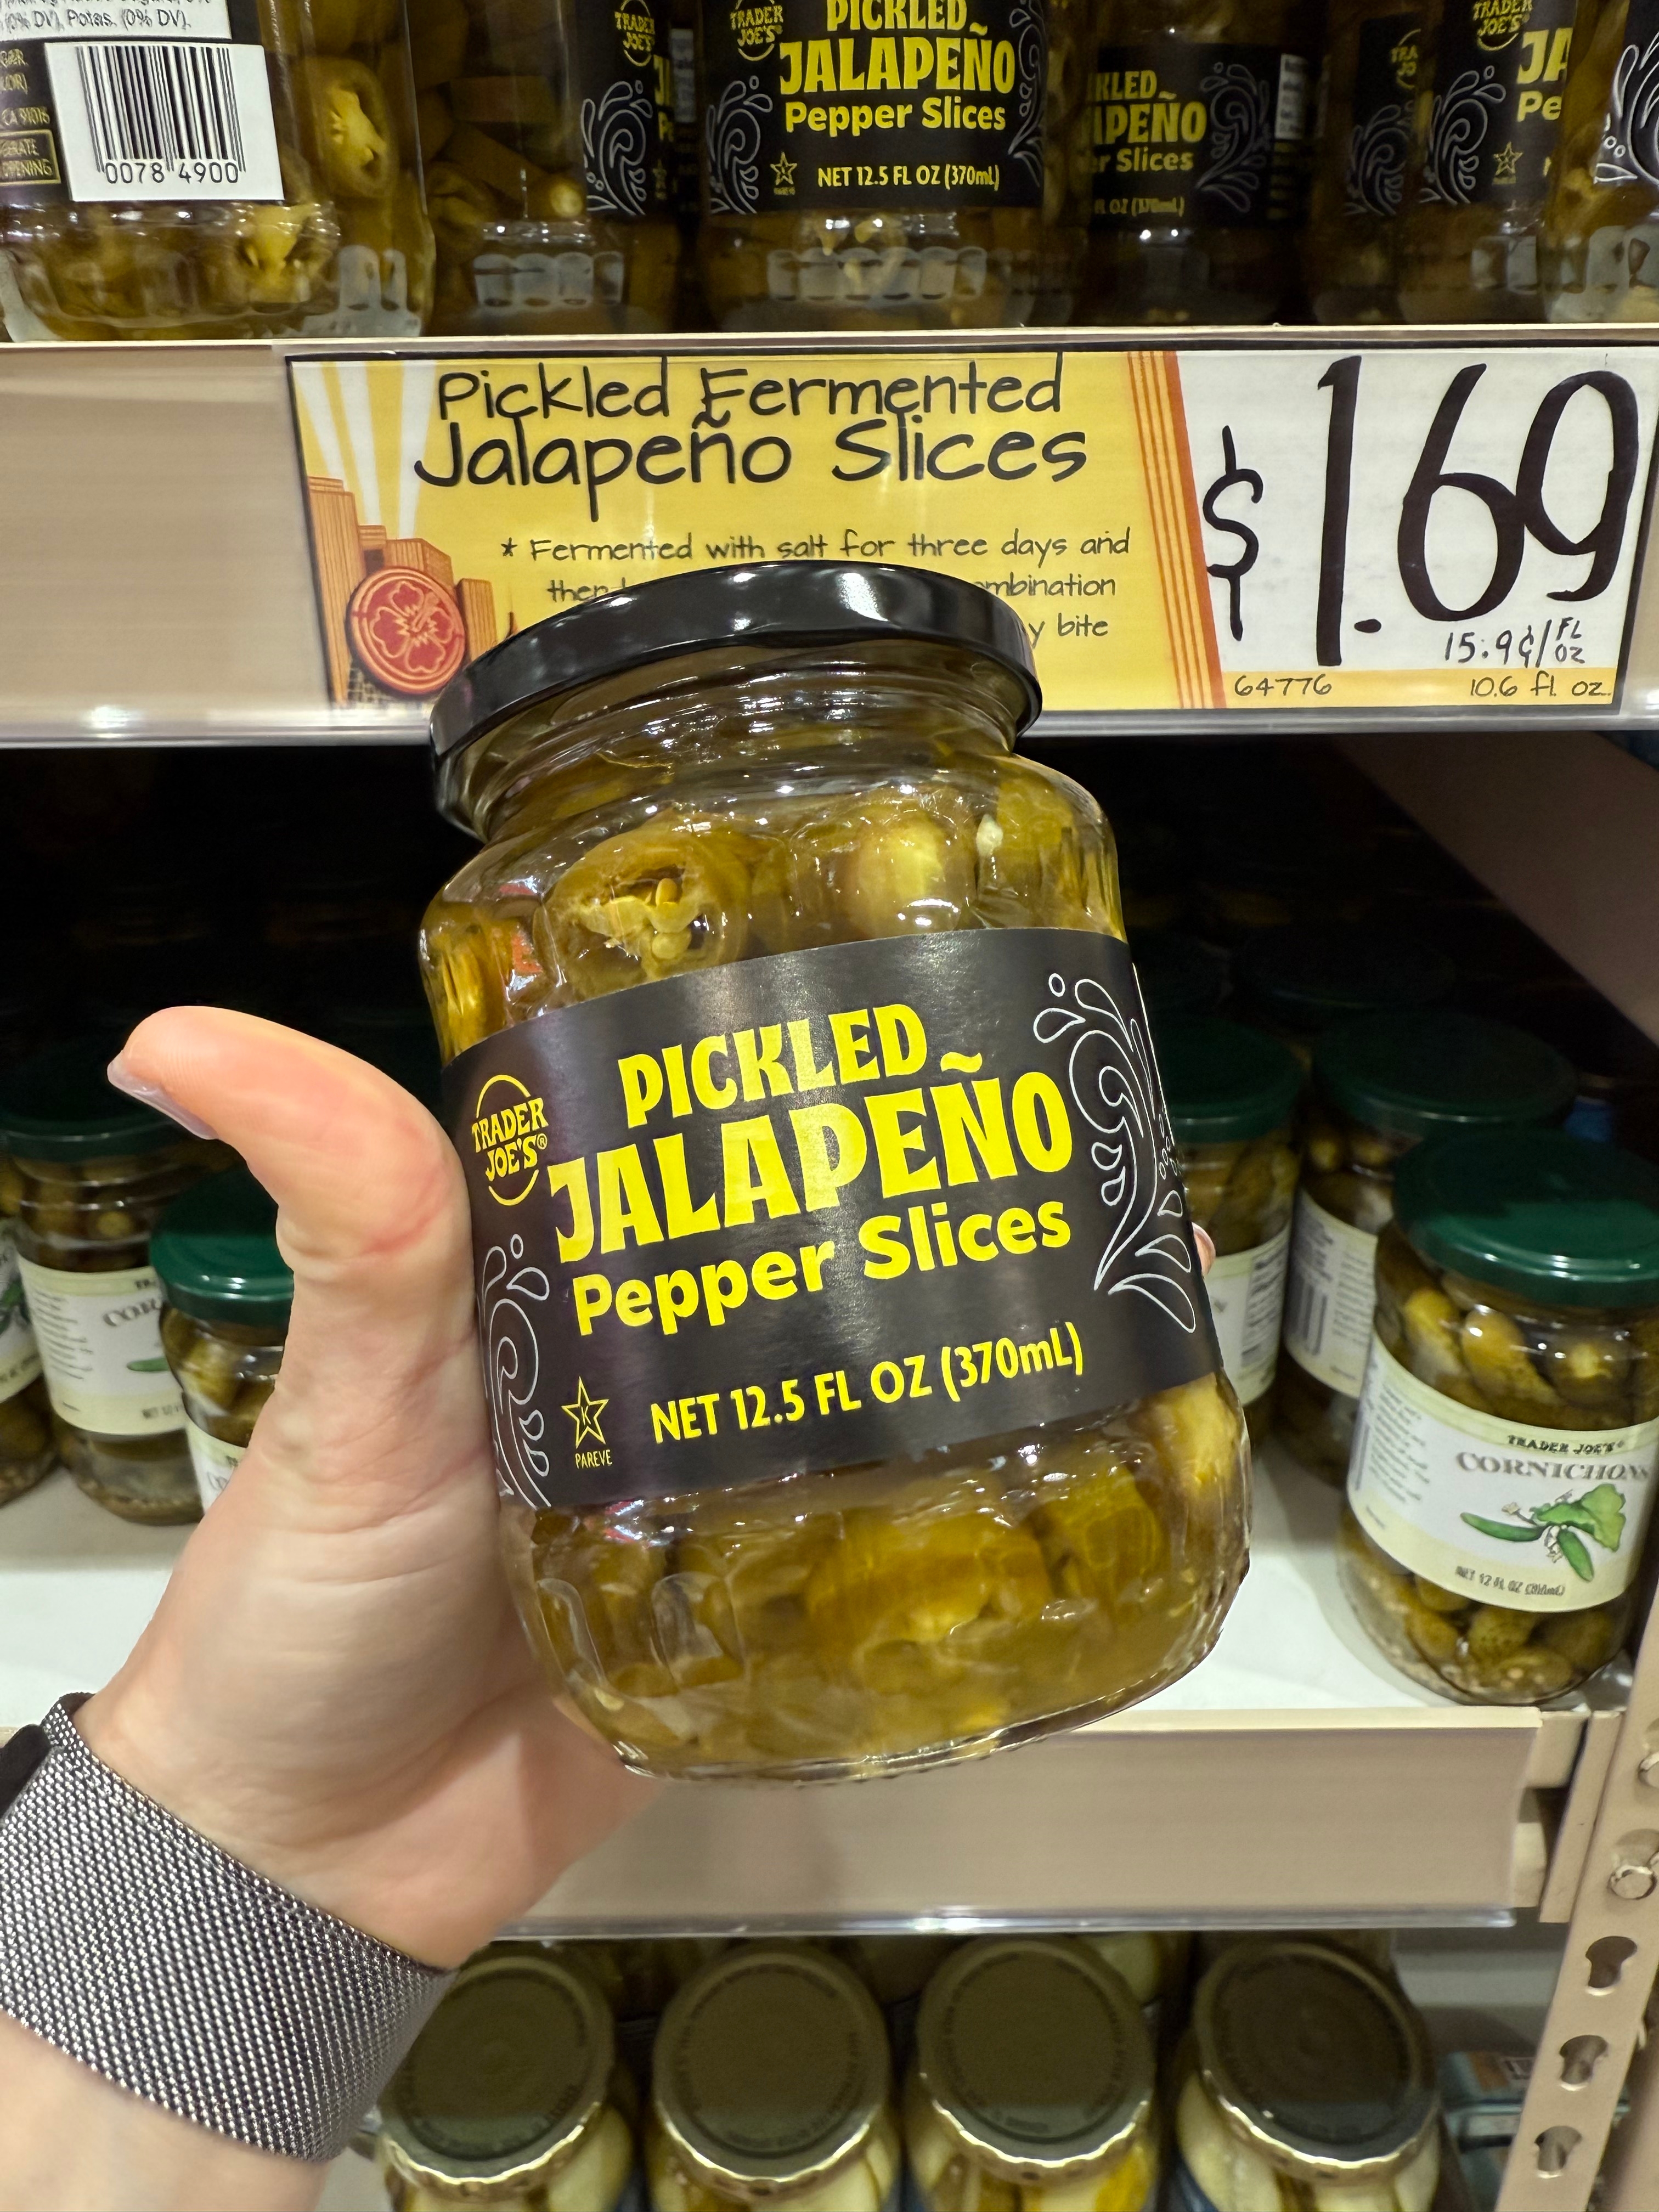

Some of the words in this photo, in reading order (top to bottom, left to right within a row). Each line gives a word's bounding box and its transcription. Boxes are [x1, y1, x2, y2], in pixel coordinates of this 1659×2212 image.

[121, 9, 153, 31] (0%
[730, 4, 784, 30] TRADER
[826, 0, 968, 32] PICKLED
[779, 22, 1015, 94] JALAPEÑO
[785, 101, 912, 138] Pepper
[922, 95, 1006, 131] Slices
[1116, 146, 1194, 172] Slices
[817, 166, 853, 188] NET
[856, 166, 889, 187] 12.5
[893, 165, 912, 187] FL
[916, 165, 941, 185] OZ
[944, 163, 1000, 191] (370mL)
[439, 356, 669, 421] Pickled
[700, 352, 1063, 417] Fermented
[414, 410, 792, 523] Jalapeño
[832, 413, 1087, 483] Slices
[529, 532, 693, 561] Fermented
[706, 534, 766, 560] with
[777, 534, 827, 557] salt
[840, 528, 895, 558] for
[907, 533, 988, 556] three
[1001, 528, 1068, 567] days
[1080, 527, 1131, 555] and
[974, 571, 1116, 596] mbination
[1057, 612, 1109, 637] bite
[1234, 673, 1332, 696] 64776
[1470, 675, 1518, 697] 10.6
[618, 1003, 927, 1128] PICKLED
[471, 1097, 549, 1153] TRADER
[547, 1051, 1073, 1263] JALAPEÑO
[571, 1238, 835, 1336] Pepper
[858, 1200, 1071, 1280] Slices
[650, 1393, 721, 1444] NET
[730, 1379, 805, 1431] 12.5
[815, 1369, 862, 1416] FL
[870, 1355, 933, 1403] OZ
[941, 1321, 1084, 1402] (370mL)
[575, 1449, 613, 1469] PAREVE
[1508, 1434, 1570, 1453] TRADER
